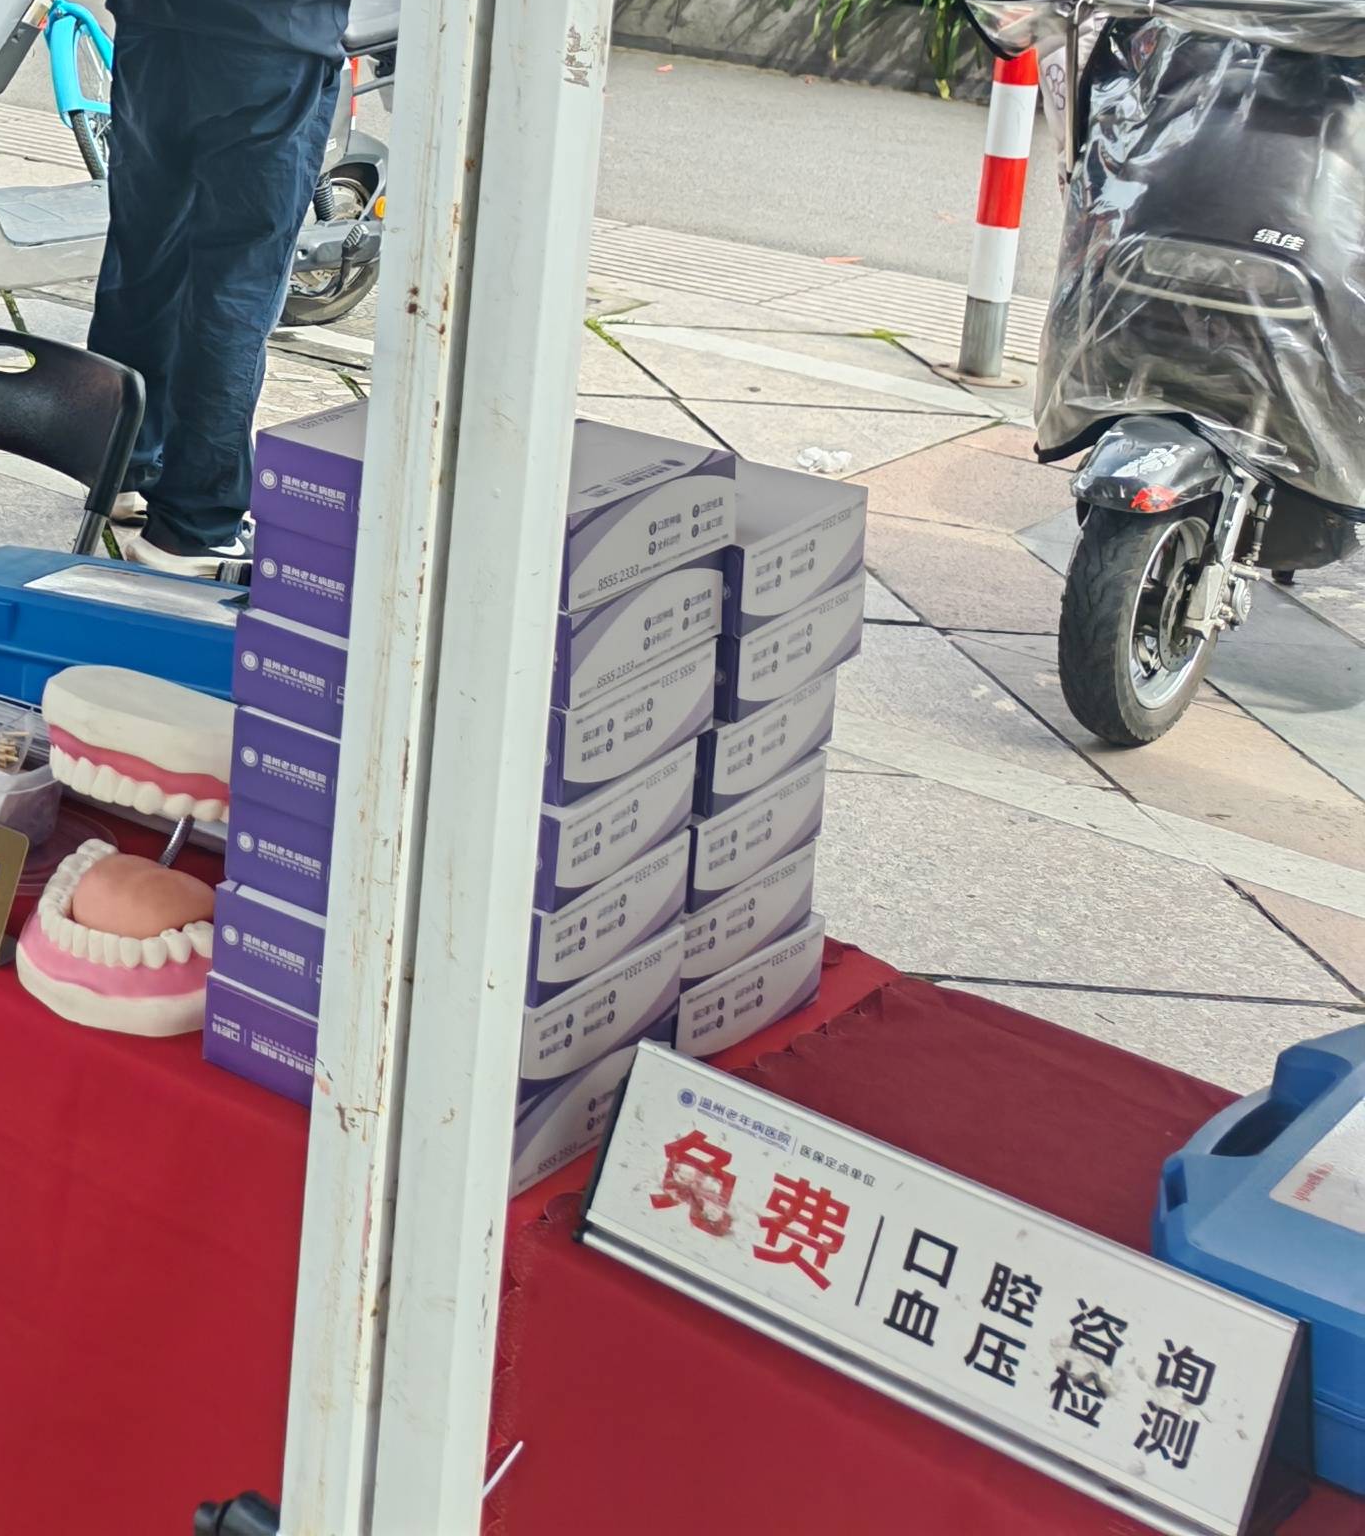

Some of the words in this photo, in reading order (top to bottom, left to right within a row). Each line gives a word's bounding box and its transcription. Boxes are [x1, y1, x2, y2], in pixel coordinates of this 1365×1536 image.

[1253, 228, 1305, 251] 绿佳
[597, 571, 619, 592] 8555
[619, 563, 640, 583] 2333
[698, 1096, 793, 1145] 温州老年病医院
[799, 1143, 876, 1188] 医保定点单位
[650, 1129, 851, 1291] 免费
[882, 1288, 1200, 1470] 血压检测
[903, 1227, 1216, 1406] 口腔咨询
